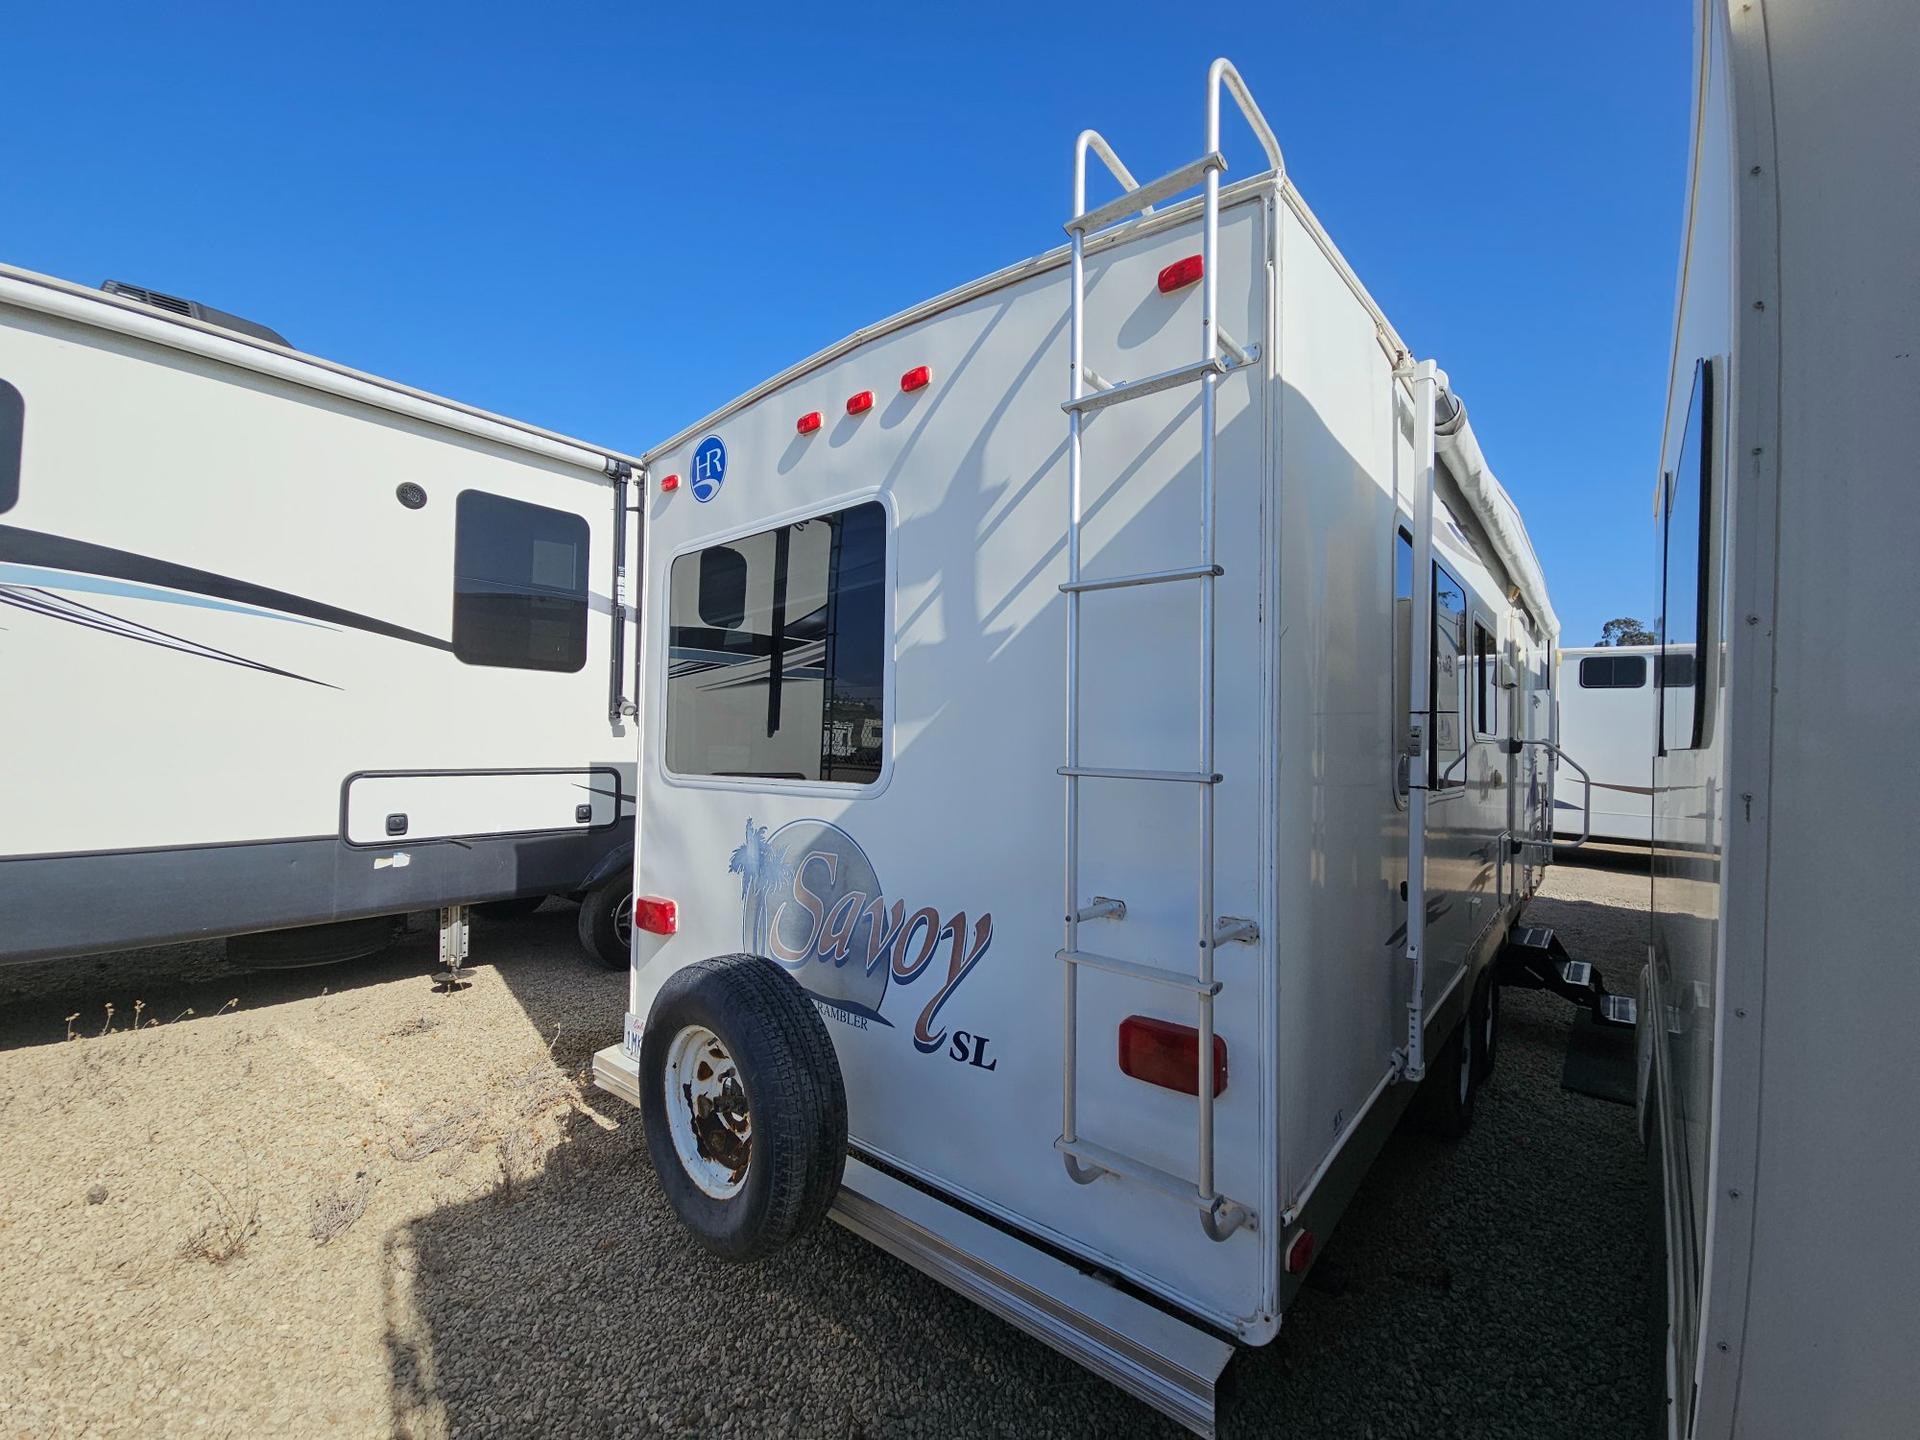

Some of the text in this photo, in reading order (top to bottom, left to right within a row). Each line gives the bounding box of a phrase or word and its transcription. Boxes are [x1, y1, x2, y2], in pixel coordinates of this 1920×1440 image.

[695, 448, 723, 482] HR
[769, 850, 994, 1054] Savoy
[950, 1030, 998, 1072] SL
